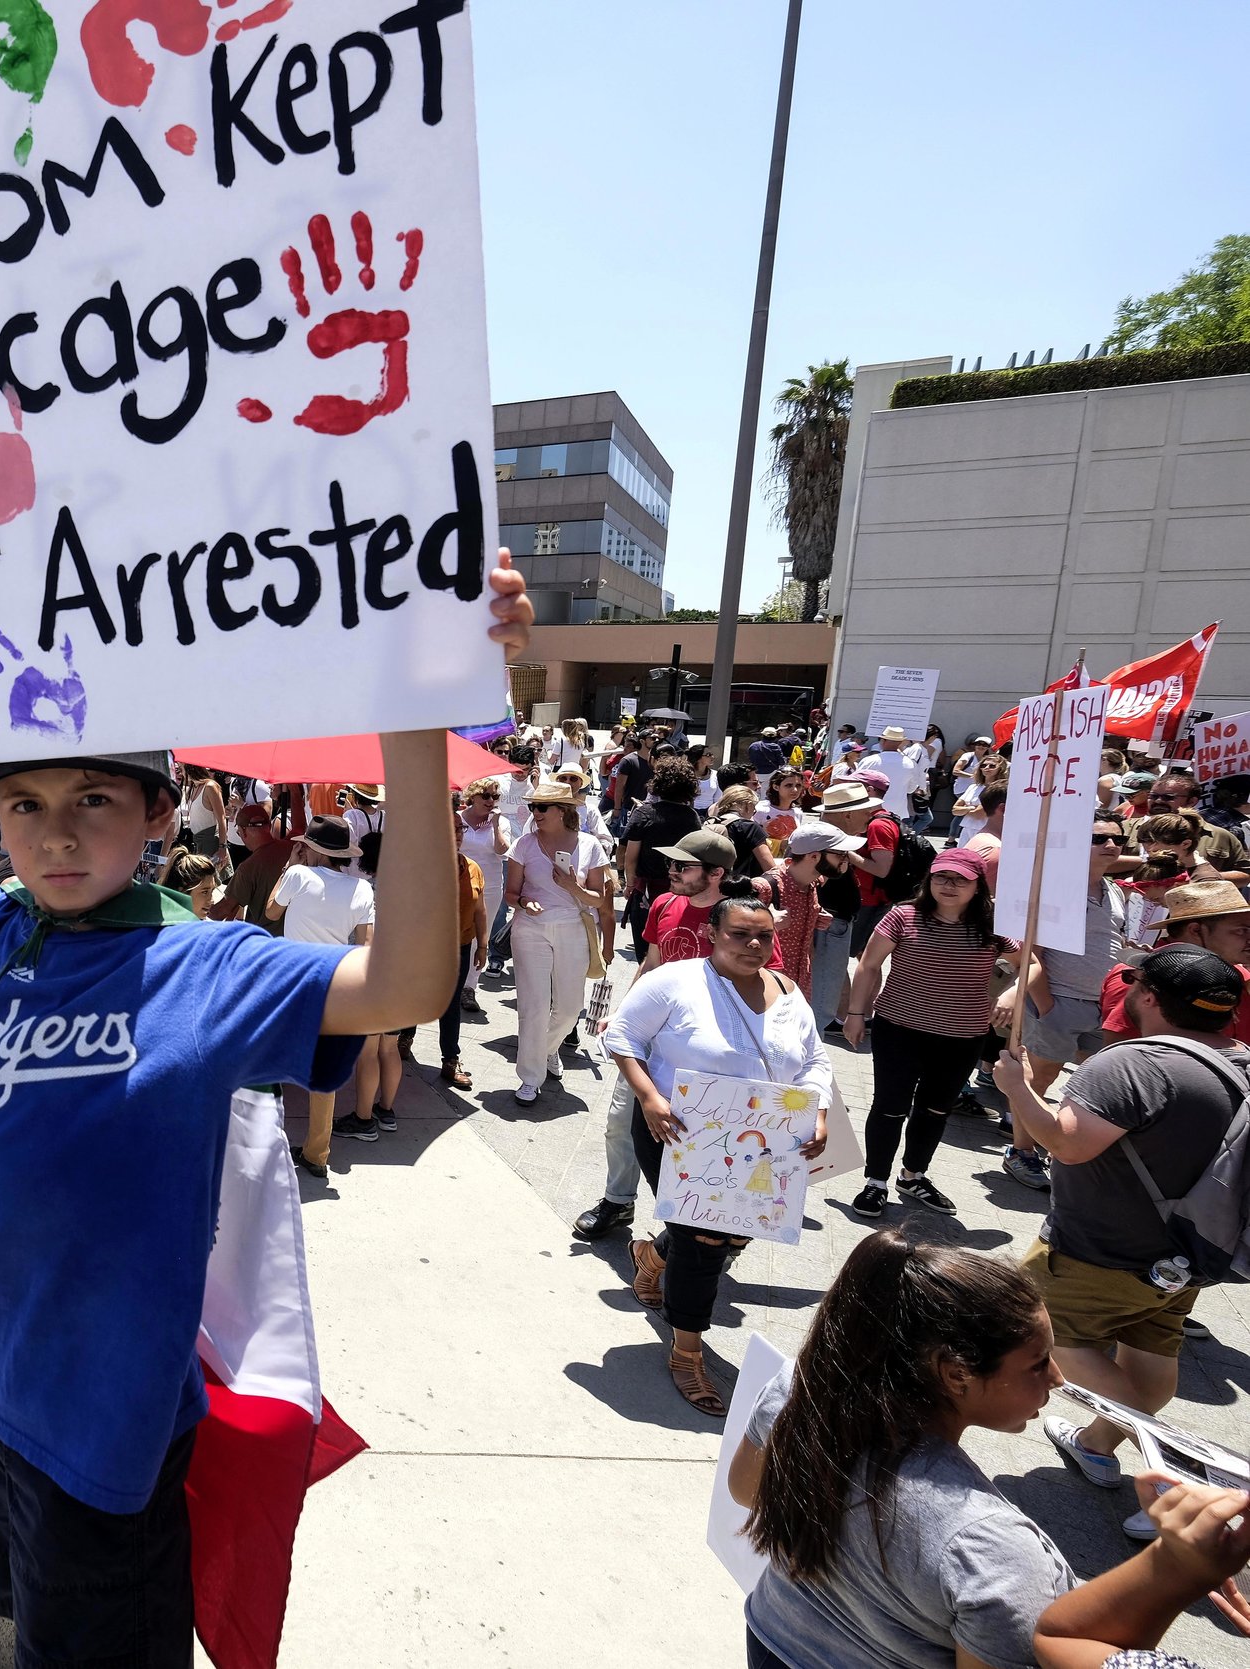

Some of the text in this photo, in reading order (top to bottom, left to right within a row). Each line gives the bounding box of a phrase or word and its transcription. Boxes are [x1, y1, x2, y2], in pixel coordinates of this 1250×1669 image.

[38, 441, 485, 651] Arrested
[1016, 690, 1106, 752] ABOLISH
[1204, 722, 1237, 743] NO
[1197, 739, 1250, 766] HUMA
[681, 1079, 799, 1135] Liberen
[702, 1130, 738, 1157] A
[674, 1190, 754, 1229] Niños
